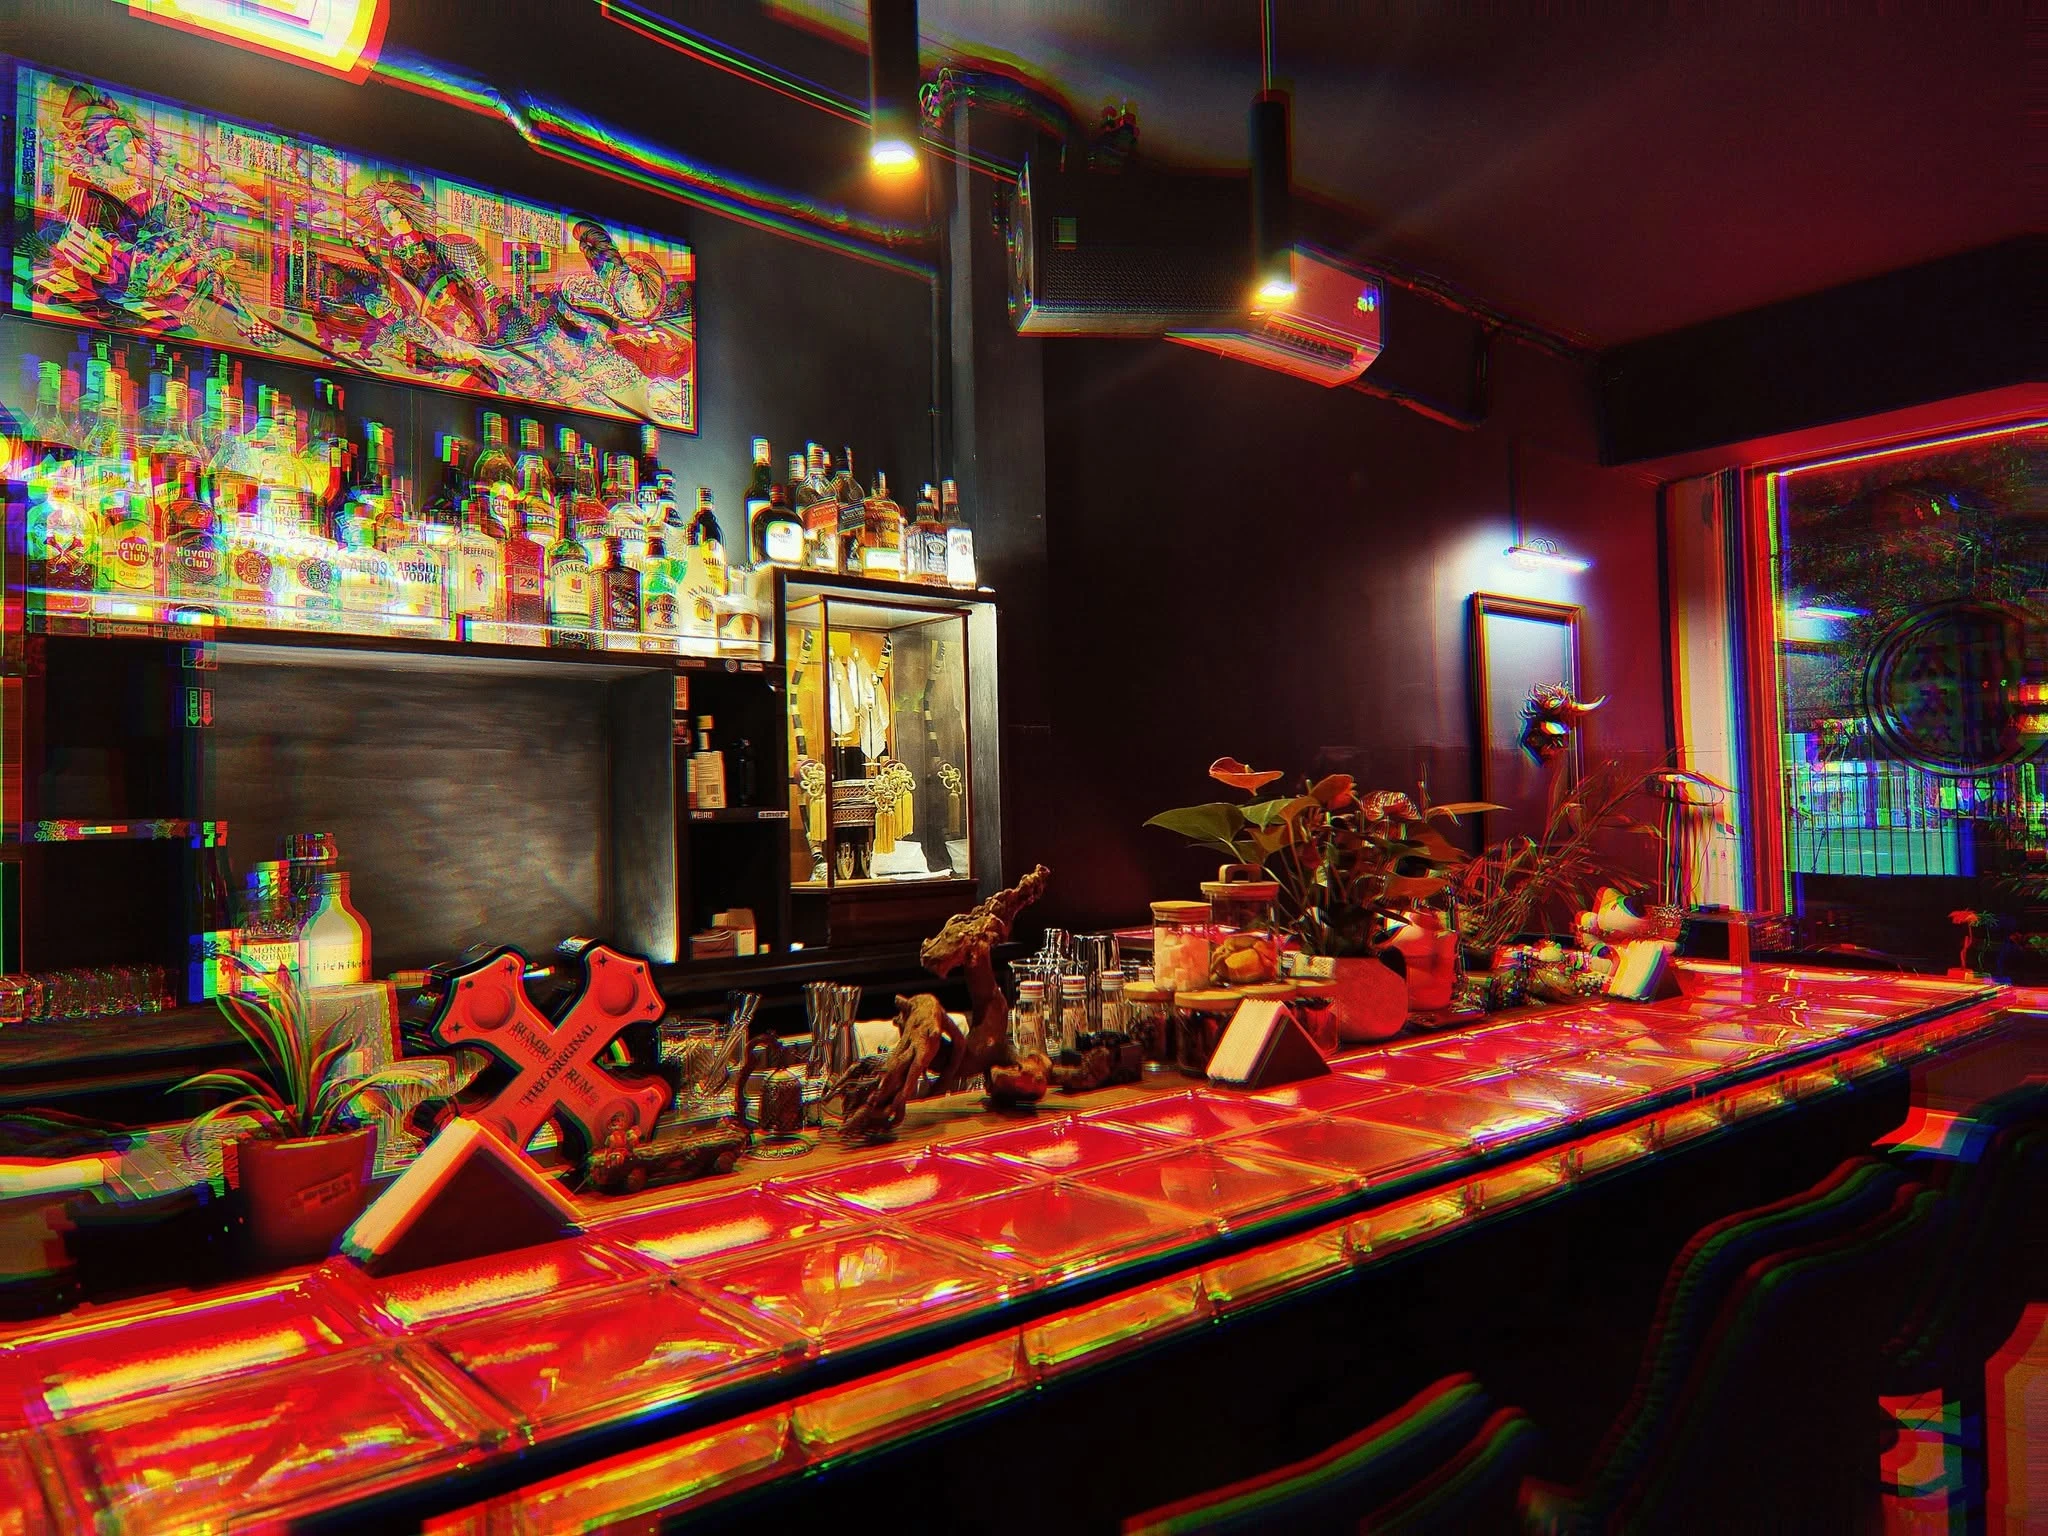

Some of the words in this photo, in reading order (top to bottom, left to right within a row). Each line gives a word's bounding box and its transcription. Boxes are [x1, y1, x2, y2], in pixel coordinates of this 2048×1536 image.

[527, 515, 554, 526] RICAR
[113, 540, 149, 553] Havan
[463, 545, 494, 558] BEEFEATER
[121, 550, 146, 563] Club
[184, 557, 209, 569] Club
[397, 561, 442, 574] ABSOLUT
[554, 563, 589, 577] JAMES
[402, 572, 438, 585] VODKA
